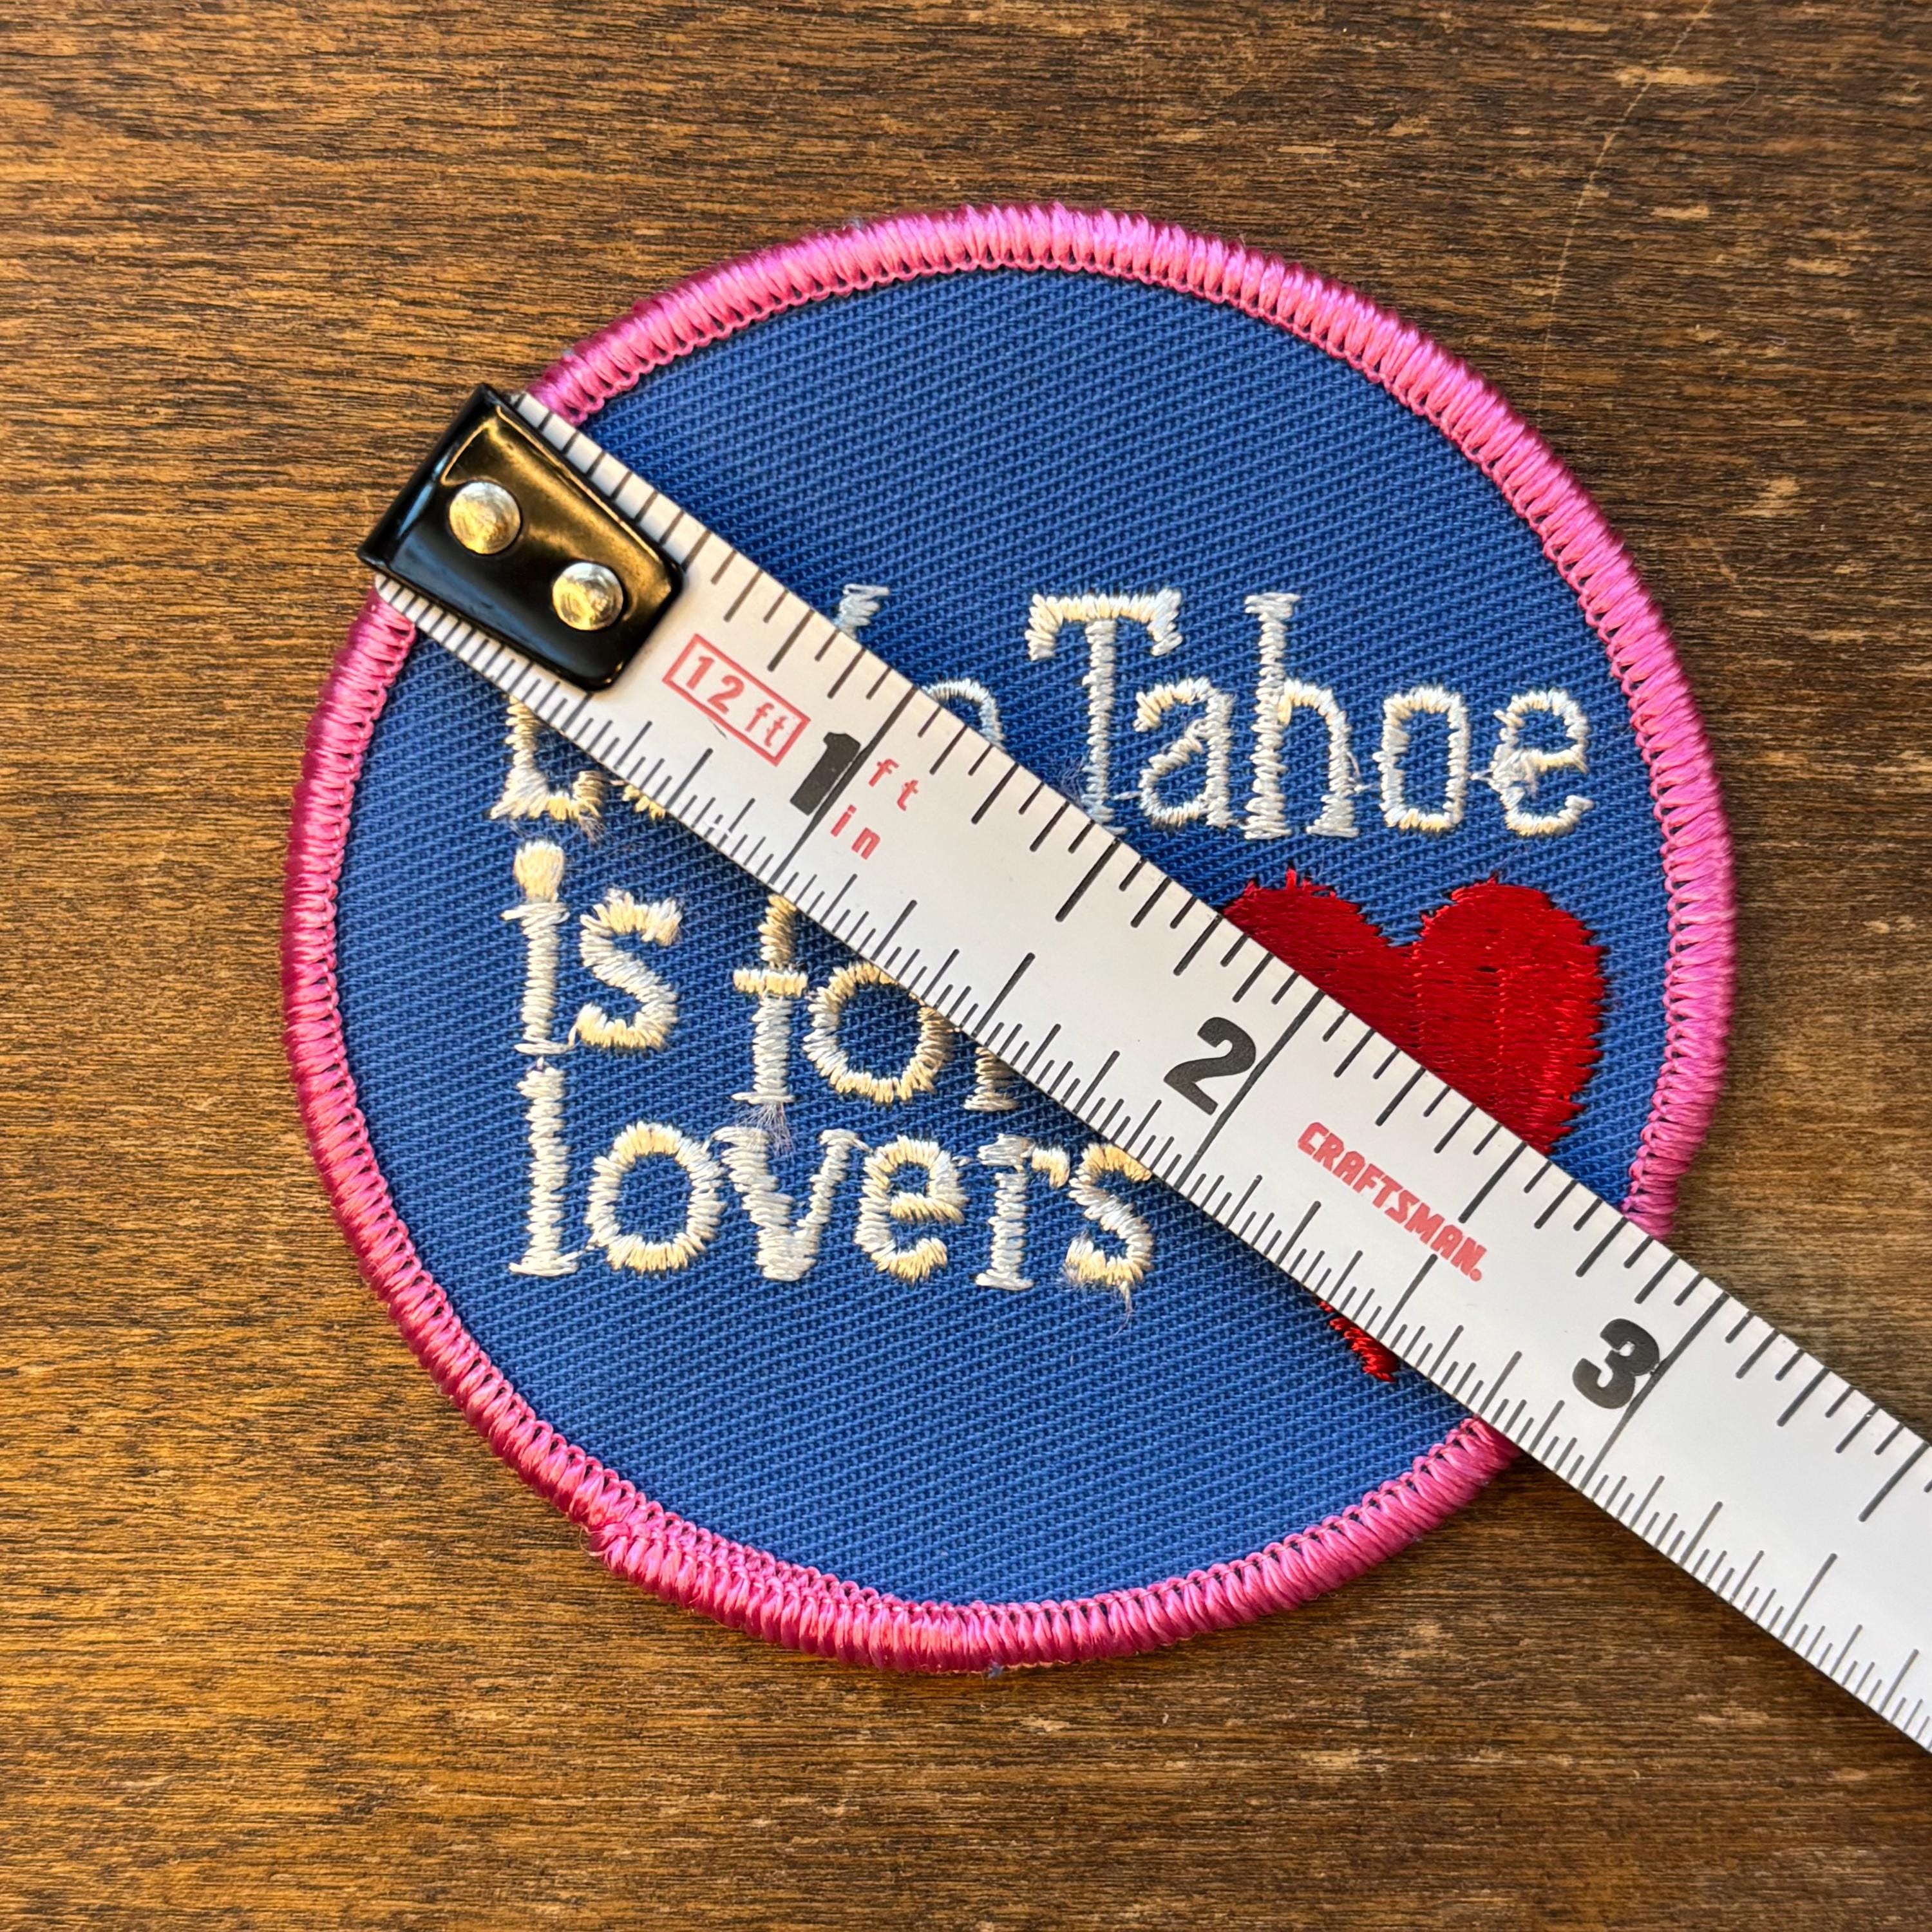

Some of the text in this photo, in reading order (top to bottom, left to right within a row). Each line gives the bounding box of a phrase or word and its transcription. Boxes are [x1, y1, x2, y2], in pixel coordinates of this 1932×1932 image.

[686, 656, 788, 747] 12 ft
[1027, 589, 1594, 840] Tahoe
[790, 732, 861, 816] 1
[868, 759, 919, 811] ft
[830, 804, 881, 860] in
[1164, 1016, 1256, 1116] 2
[509, 1059, 1154, 1290] lovers
[1572, 1318, 1660, 1409] 3
